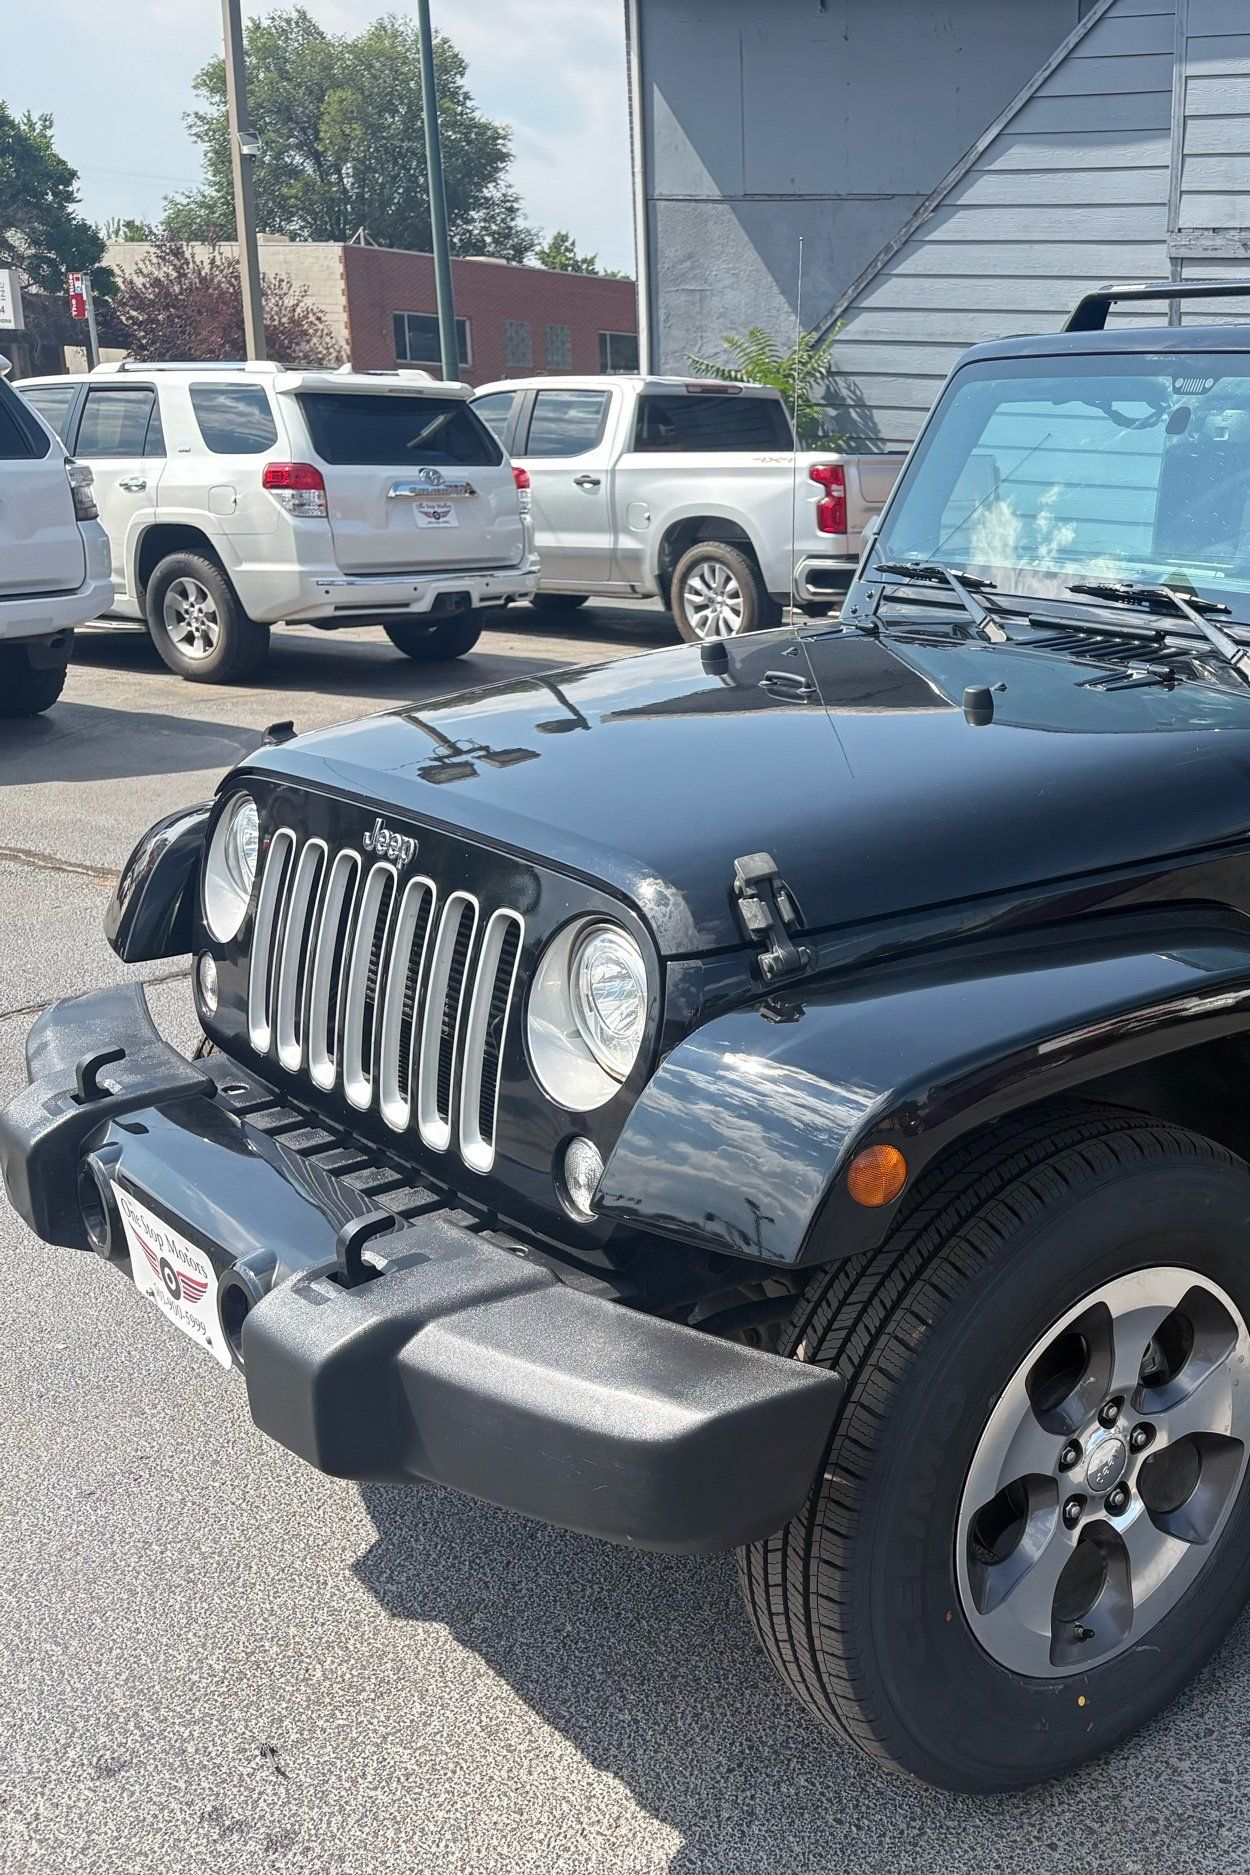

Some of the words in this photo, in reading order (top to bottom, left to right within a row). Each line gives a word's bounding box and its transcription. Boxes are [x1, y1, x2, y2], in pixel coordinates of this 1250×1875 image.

[363, 817, 419, 870] Jeep
[121, 1198, 141, 1228] One
[140, 1215, 164, 1253] Stop
[164, 1233, 208, 1279] Motors
